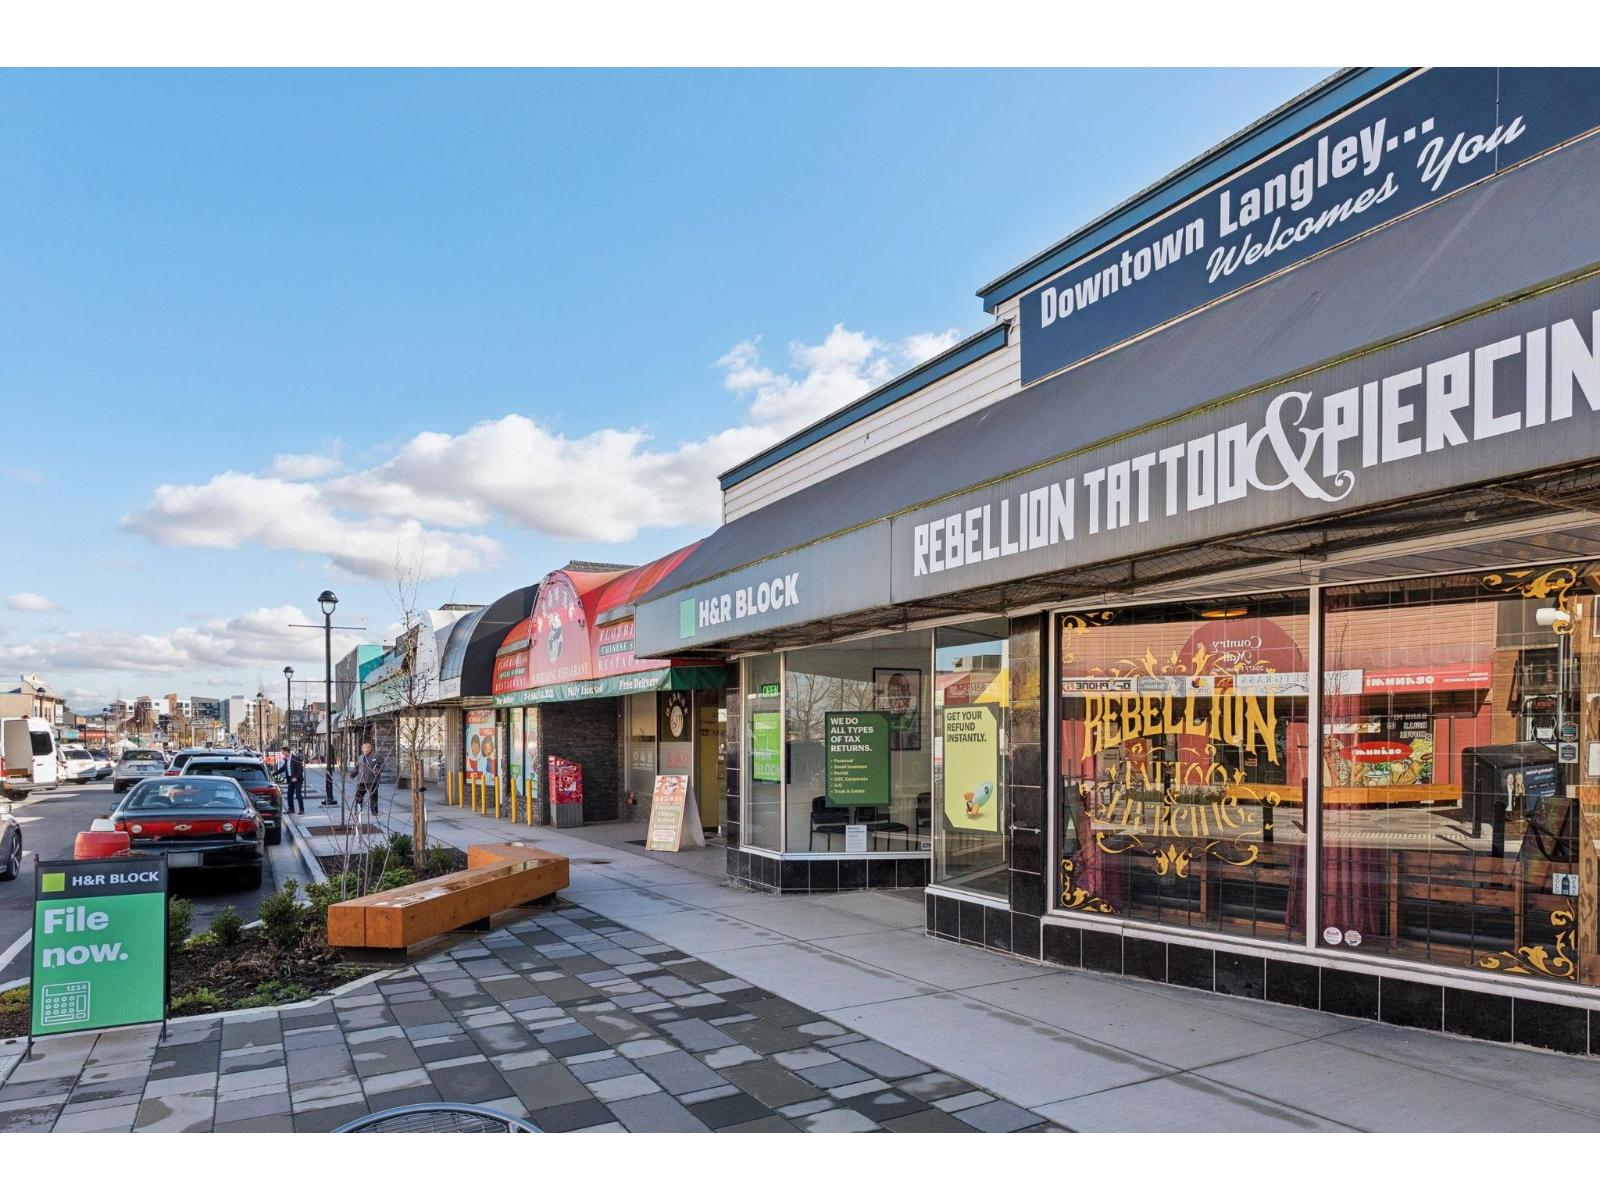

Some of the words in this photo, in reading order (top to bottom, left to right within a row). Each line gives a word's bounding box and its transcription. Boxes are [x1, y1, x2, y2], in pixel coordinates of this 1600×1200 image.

[1206, 172, 1399, 283] Welcomes
[1417, 115, 1525, 190] You
[1041, 217, 1204, 328] Downtown
[1220, 117, 1435, 232] Langley...
[914, 479, 1074, 576] REBELLION
[1084, 423, 1247, 535] TATTOO
[1245, 391, 1354, 501] &
[699, 594, 731, 627] H&R
[736, 572, 800, 618] BLOCK
[619, 679, 634, 690] Free
[635, 676, 659, 688] Delivery
[830, 717, 844, 725] WE
[846, 717, 858, 725] DO
[946, 711, 961, 721] GET
[962, 711, 982, 720] YOUR
[831, 726, 846, 734] ALL
[848, 726, 874, 734] TYPES
[946, 722, 975, 731] REFUND
[1081, 692, 1279, 766] REBELLION
[831, 735, 842, 743] OF
[843, 735, 861, 743] TAX
[946, 733, 987, 743] INSTANTLY.
[72, 874, 105, 886] H&R
[110, 871, 159, 885] BLOCK
[44, 905, 109, 934] File
[42, 942, 128, 968] now.
[66, 983, 87, 992] 1234
